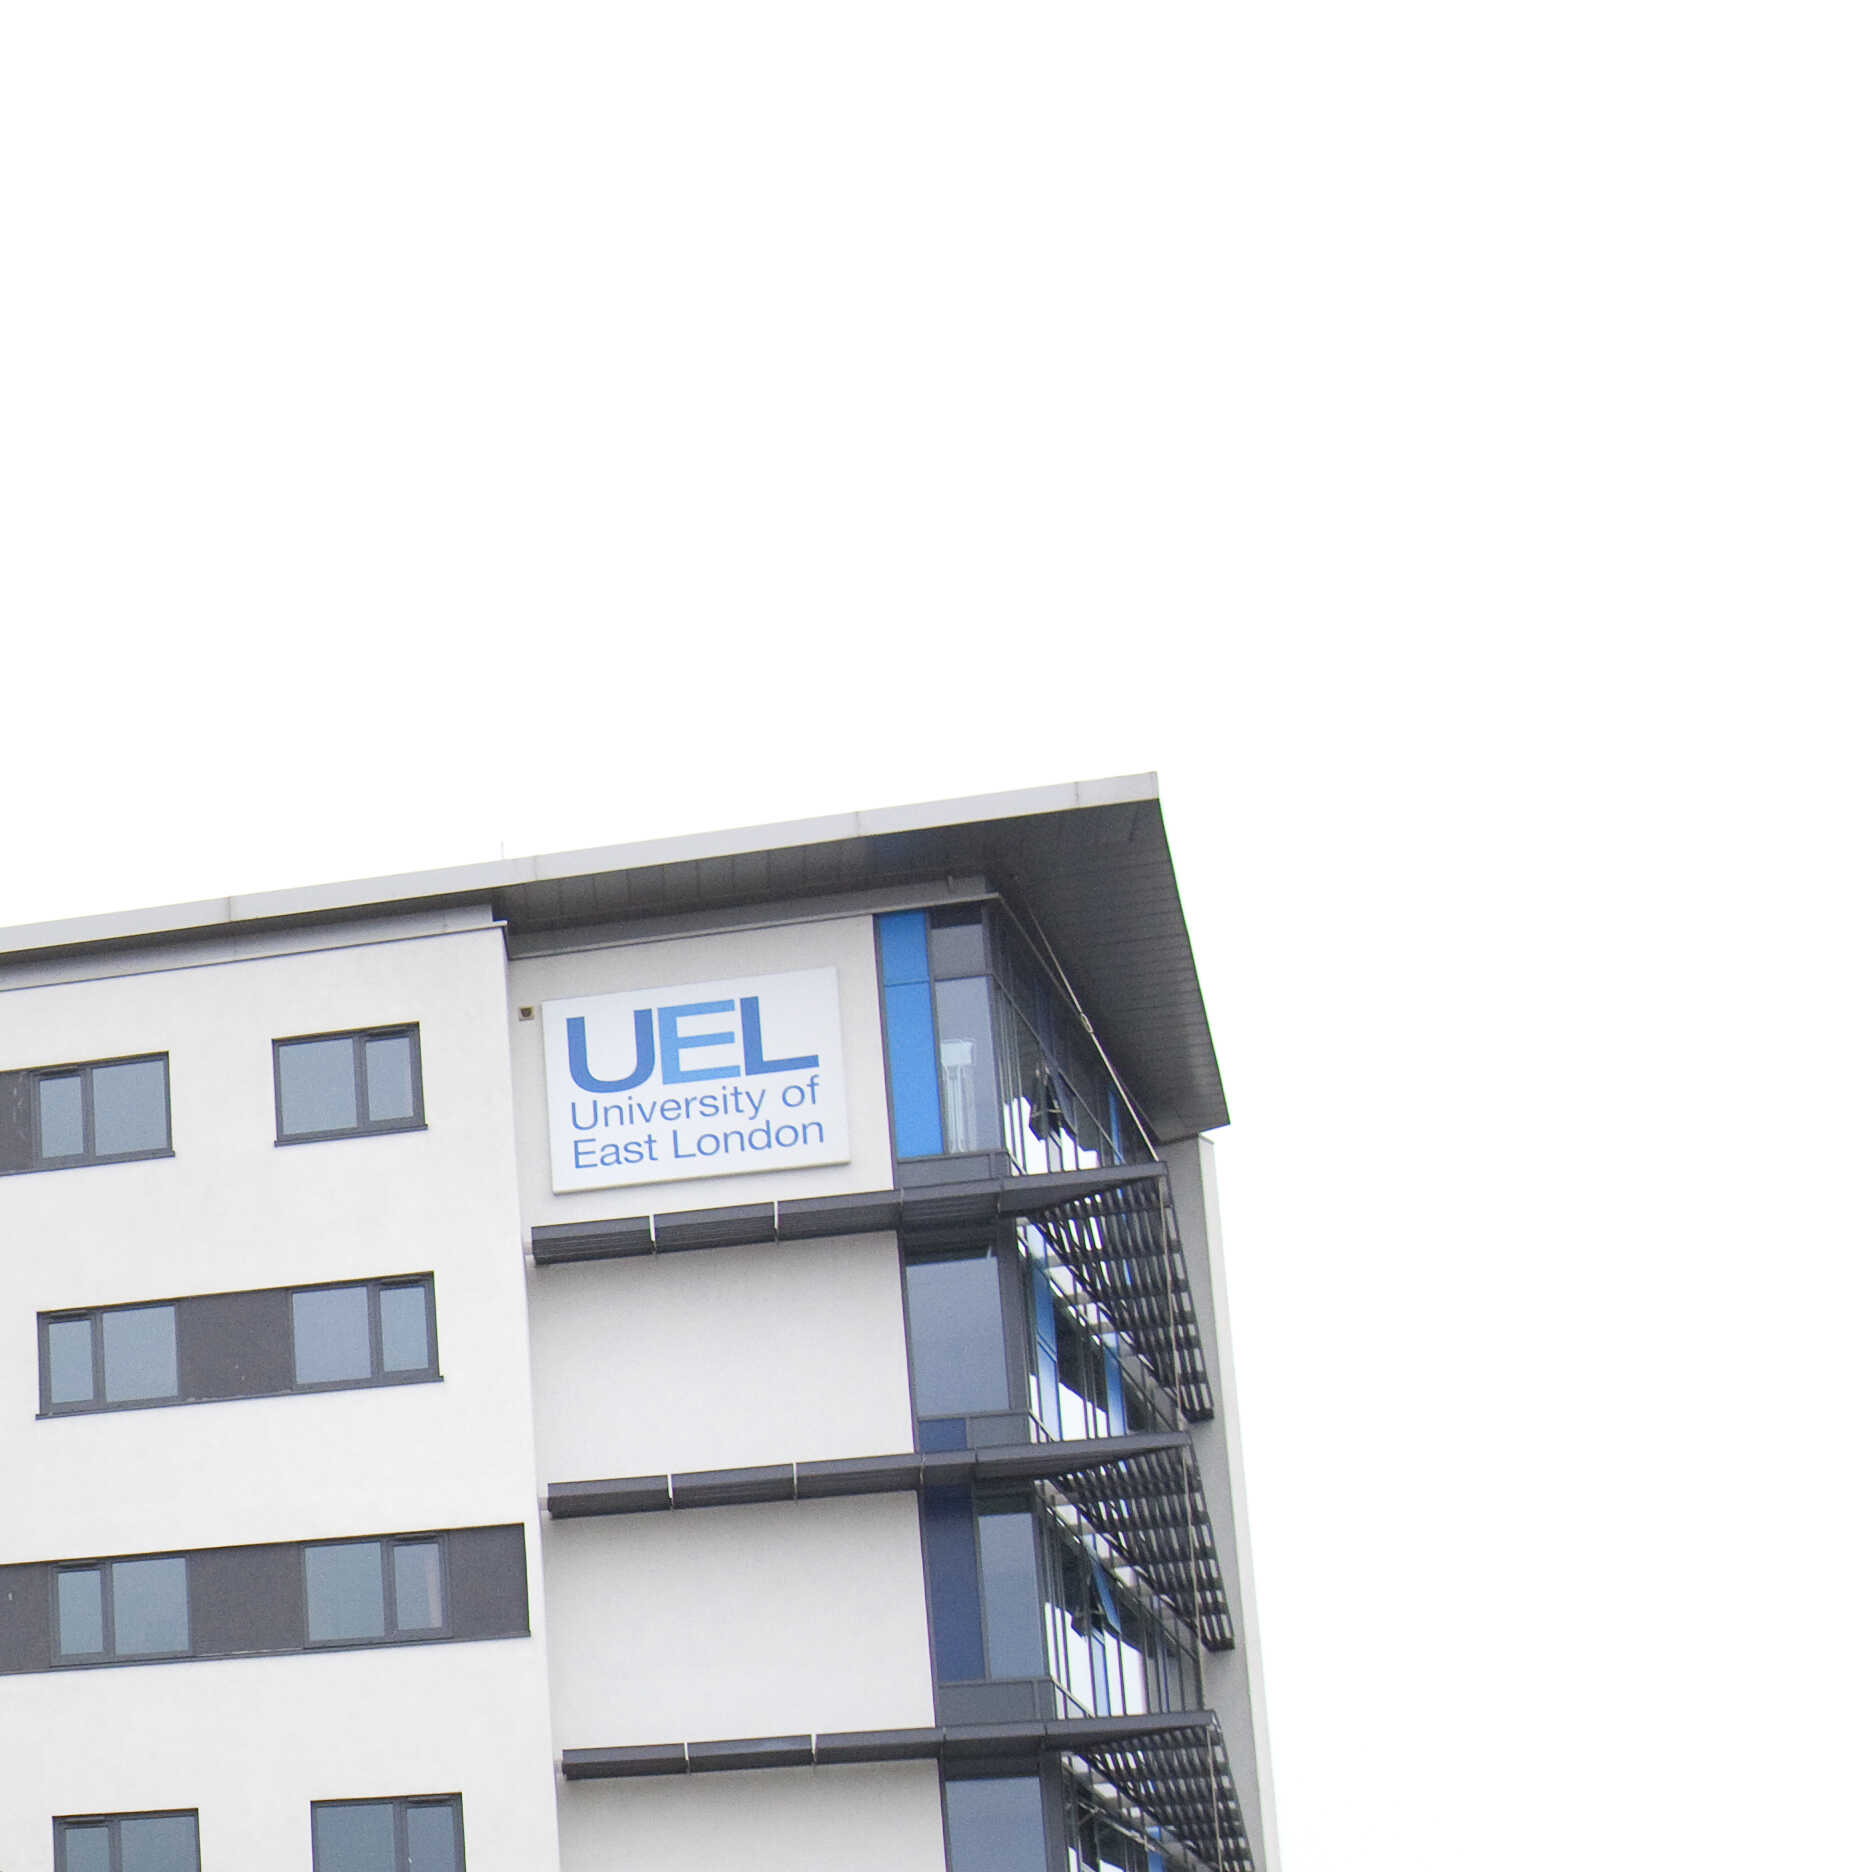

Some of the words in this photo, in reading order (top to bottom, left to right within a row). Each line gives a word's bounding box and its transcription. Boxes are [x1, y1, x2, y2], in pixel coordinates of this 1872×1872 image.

[566, 996, 820, 1093] UEL
[571, 1085, 766, 1131] University
[782, 1075, 820, 1107] of
[573, 1135, 658, 1169] East
[672, 1119, 824, 1159] London
